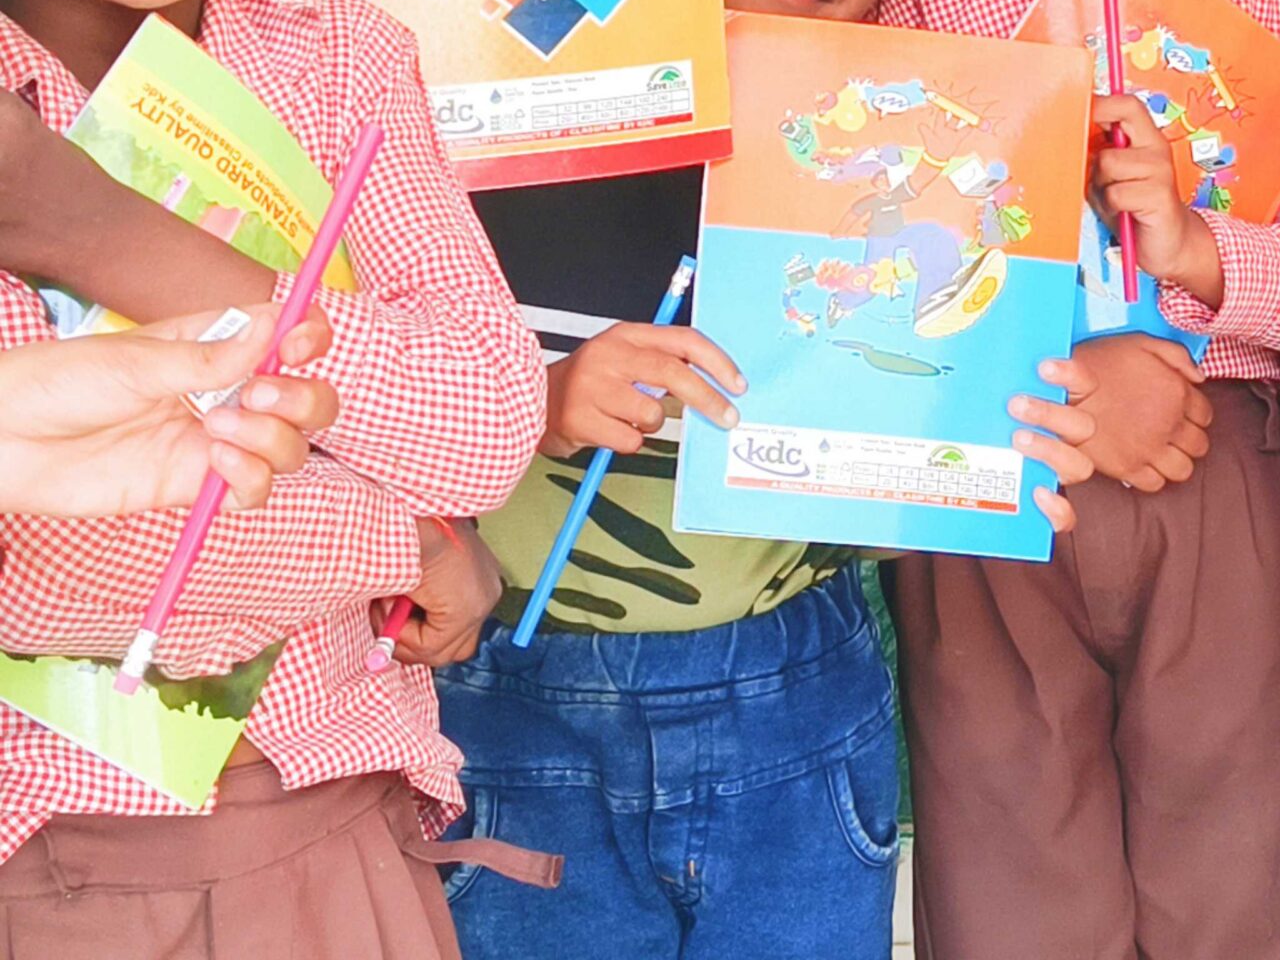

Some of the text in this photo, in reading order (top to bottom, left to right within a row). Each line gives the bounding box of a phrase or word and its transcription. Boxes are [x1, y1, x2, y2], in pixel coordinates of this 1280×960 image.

[130, 97, 299, 238] STANDARD QUALITY
[747, 437, 802, 465] kdc
